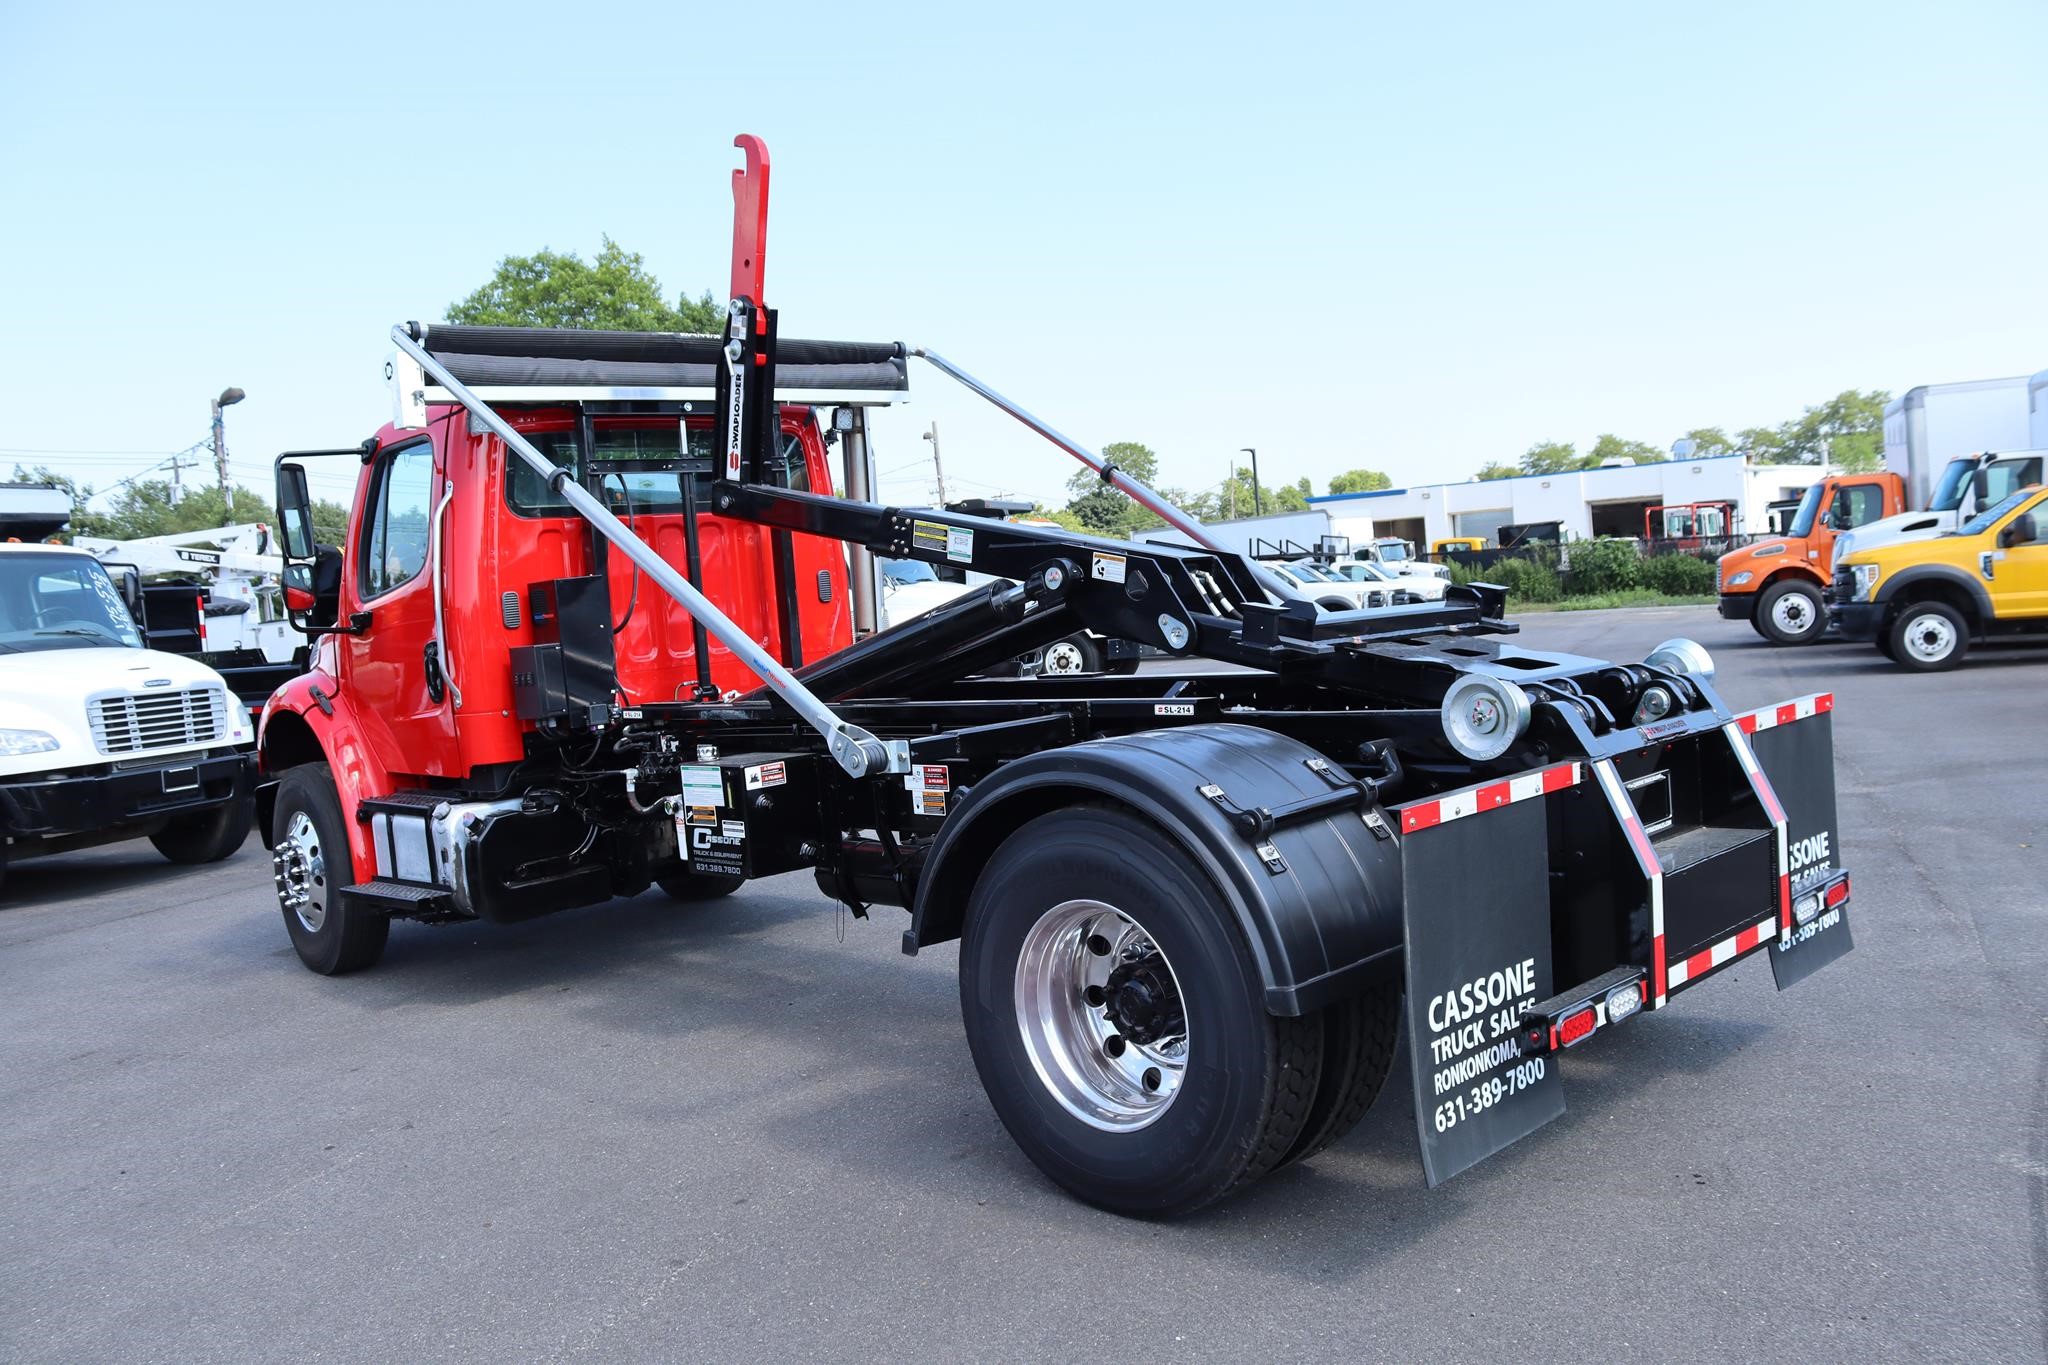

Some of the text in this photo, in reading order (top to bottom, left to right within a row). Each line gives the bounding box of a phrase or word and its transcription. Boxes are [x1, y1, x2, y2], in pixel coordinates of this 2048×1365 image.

[731, 373, 742, 449] SWAPLOADER
[190, 552, 217, 563] TEREX
[1164, 706, 1191, 714] SL-214
[696, 863, 741, 875] 631.389.7800
[1790, 831, 1830, 872] SONE
[1428, 958, 1536, 1032] CASSONE
[1430, 1019, 1485, 1065] TRUCK
[1434, 1057, 1545, 1133] 631-389-7800
